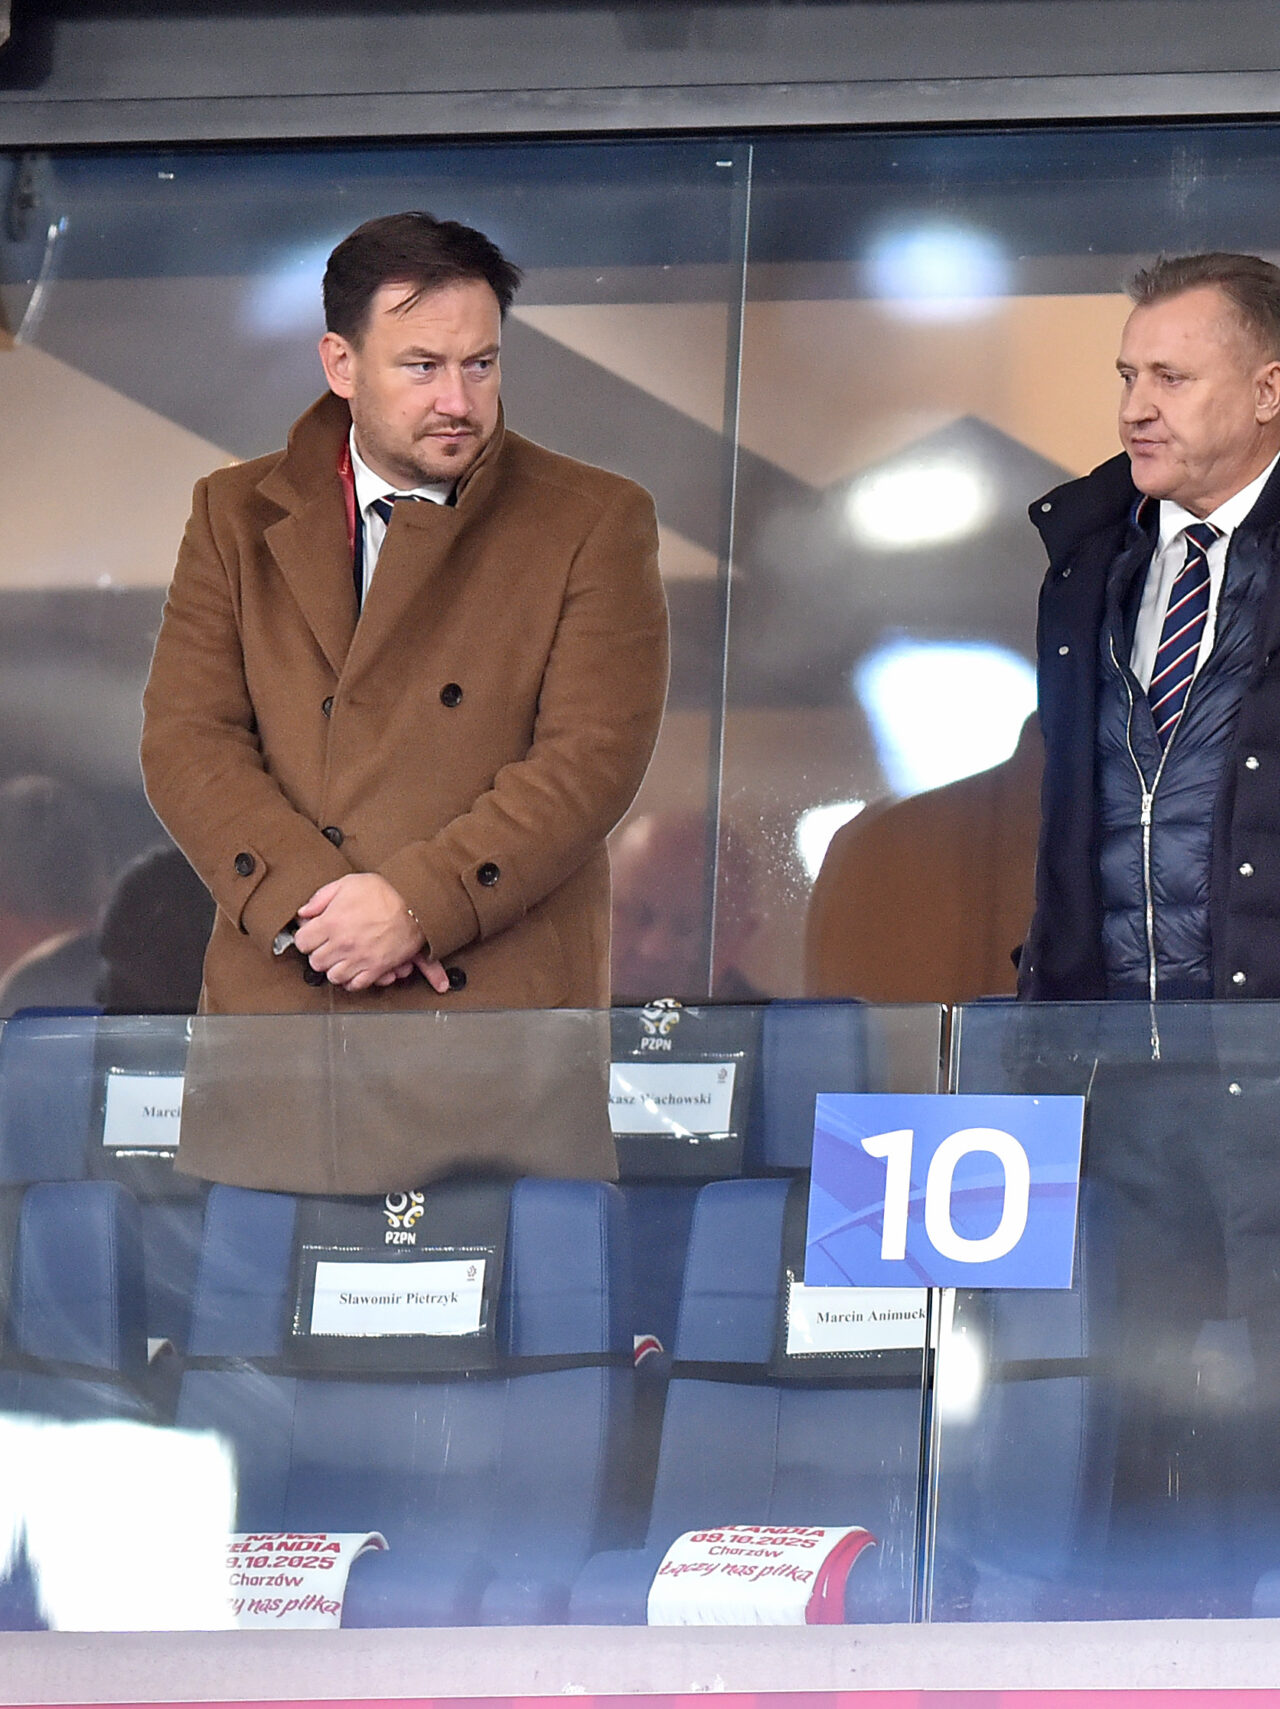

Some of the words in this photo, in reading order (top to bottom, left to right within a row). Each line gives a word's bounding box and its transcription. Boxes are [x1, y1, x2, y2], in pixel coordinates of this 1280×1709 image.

[641, 1037, 672, 1051] PZPN
[860, 1127, 1030, 1263] 10
[385, 1231, 416, 1245] PZPN
[406, 1291, 459, 1306] Pietrzyk
[816, 1310, 864, 1324] Marcin
[868, 1308, 926, 1322] Animuck
[227, 1542, 341, 1553] ELANDIA
[690, 1532, 819, 1548] 09.10.2025
[708, 1545, 784, 1557] Chorzów
[229, 1572, 304, 1586] Chorzów
[659, 1561, 720, 1577] Łączy
[721, 1563, 757, 1577] nas
[749, 1564, 814, 1583] piłka
[248, 1598, 283, 1615] nas
[276, 1595, 341, 1618] piłka
